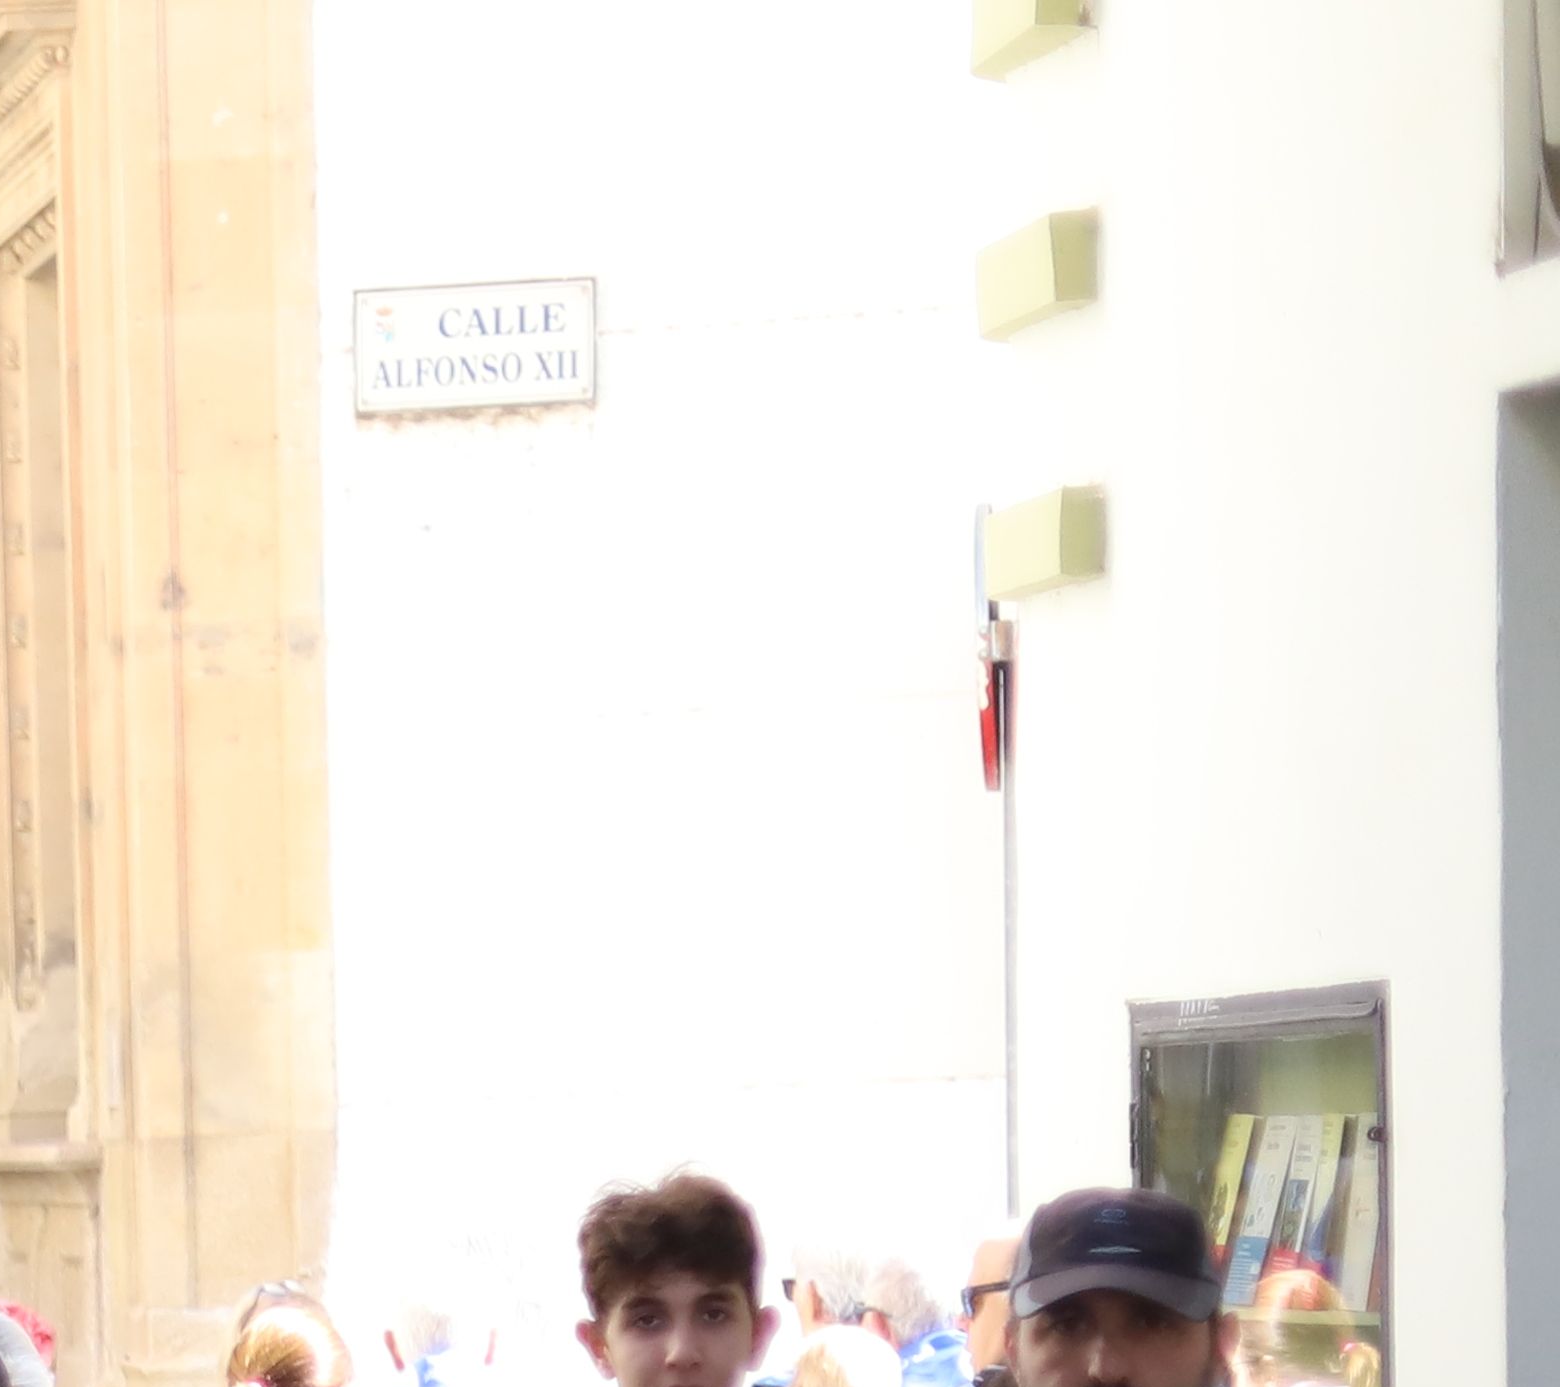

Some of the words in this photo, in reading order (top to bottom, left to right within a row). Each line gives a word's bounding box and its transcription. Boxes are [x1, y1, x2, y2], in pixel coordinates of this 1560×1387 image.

[438, 302, 567, 338] CALLE
[372, 351, 523, 390] ALFONSO
[534, 349, 580, 382] XII
